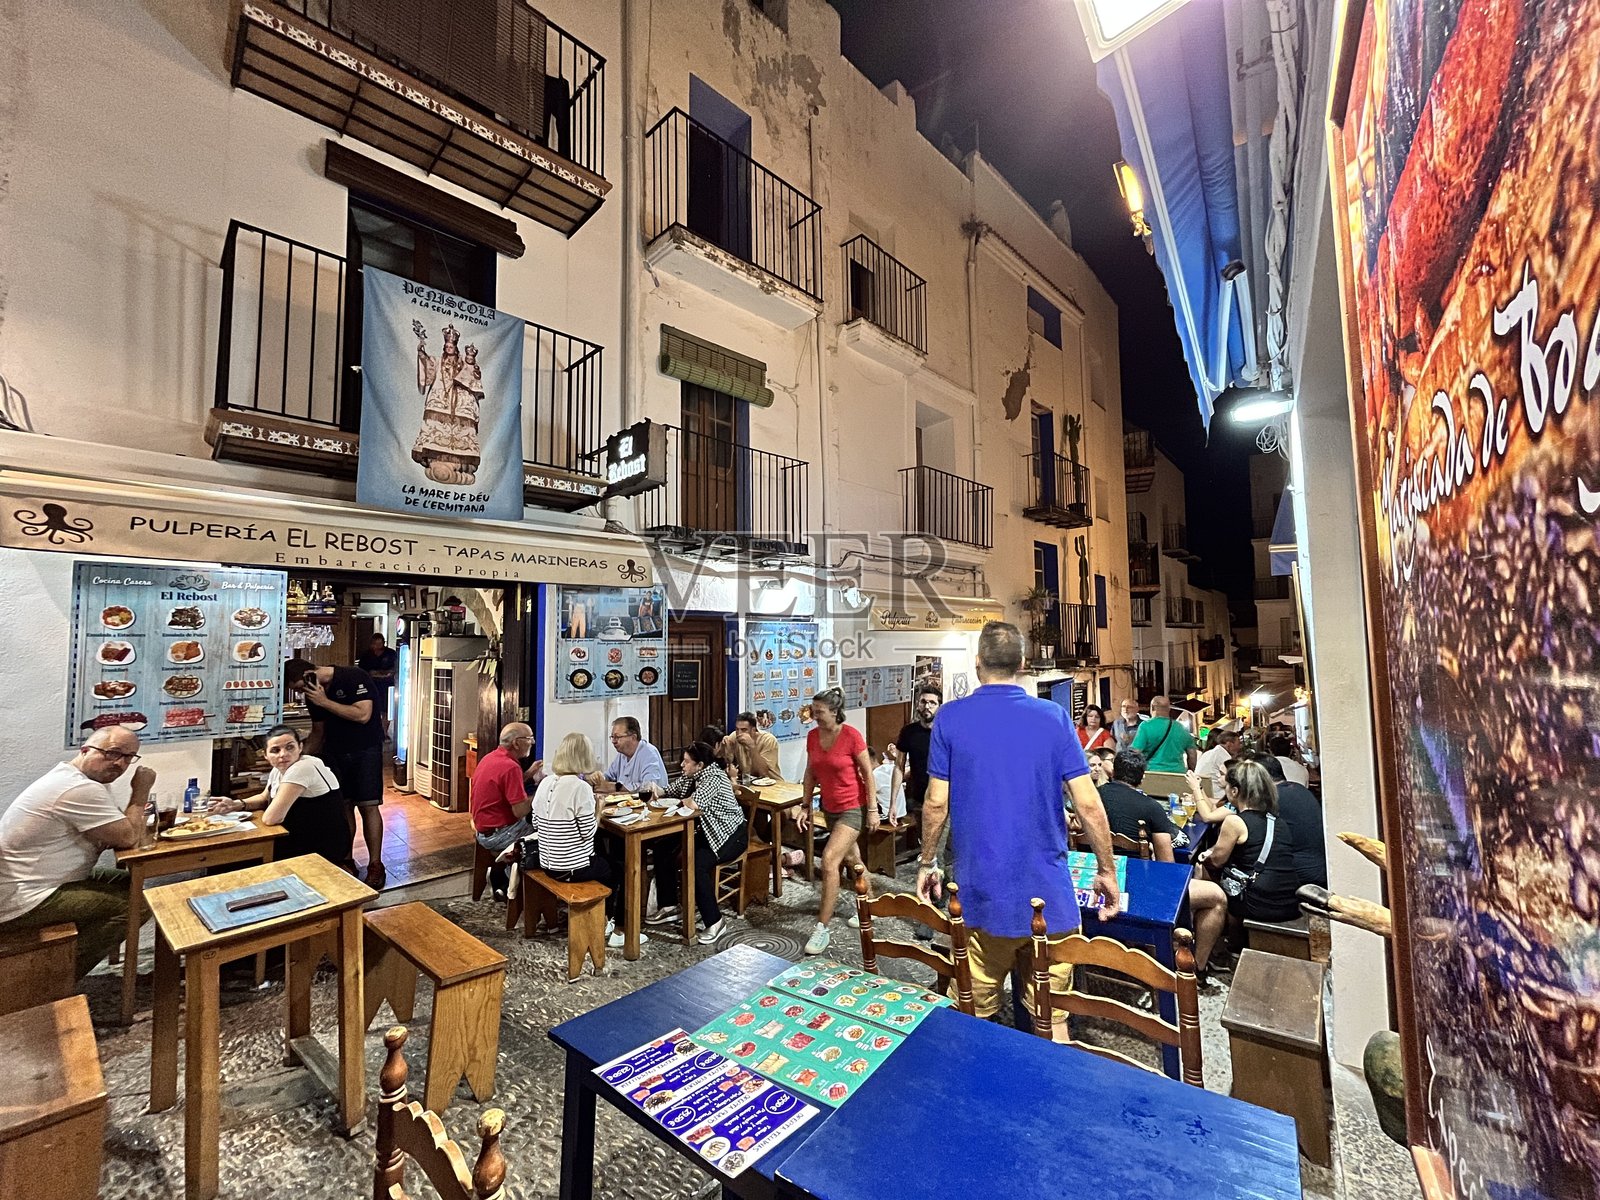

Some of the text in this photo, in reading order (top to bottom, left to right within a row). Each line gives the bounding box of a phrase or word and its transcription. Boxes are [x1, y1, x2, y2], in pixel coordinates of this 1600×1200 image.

[419, 300, 430, 309] LA
[454, 312, 489, 327] PATRONA
[1469, 372, 1509, 468] de
[608, 453, 647, 485] Rebost
[402, 484, 490, 502] LA MARE DE DÉU
[405, 496, 486, 513] DE L'ERMITANA
[130, 515, 277, 542] PULPERÍA
[287, 528, 317, 549] EL
[325, 531, 419, 556] REBOST
[443, 545, 506, 562] TAPAS
[511, 552, 609, 570] MARINERAS
[274, 552, 520, 580] Embarcación Propia
[92, 576, 122, 585] Cocina
[221, 581, 236, 590] Bar
[161, 591, 218, 602] El Rebost
